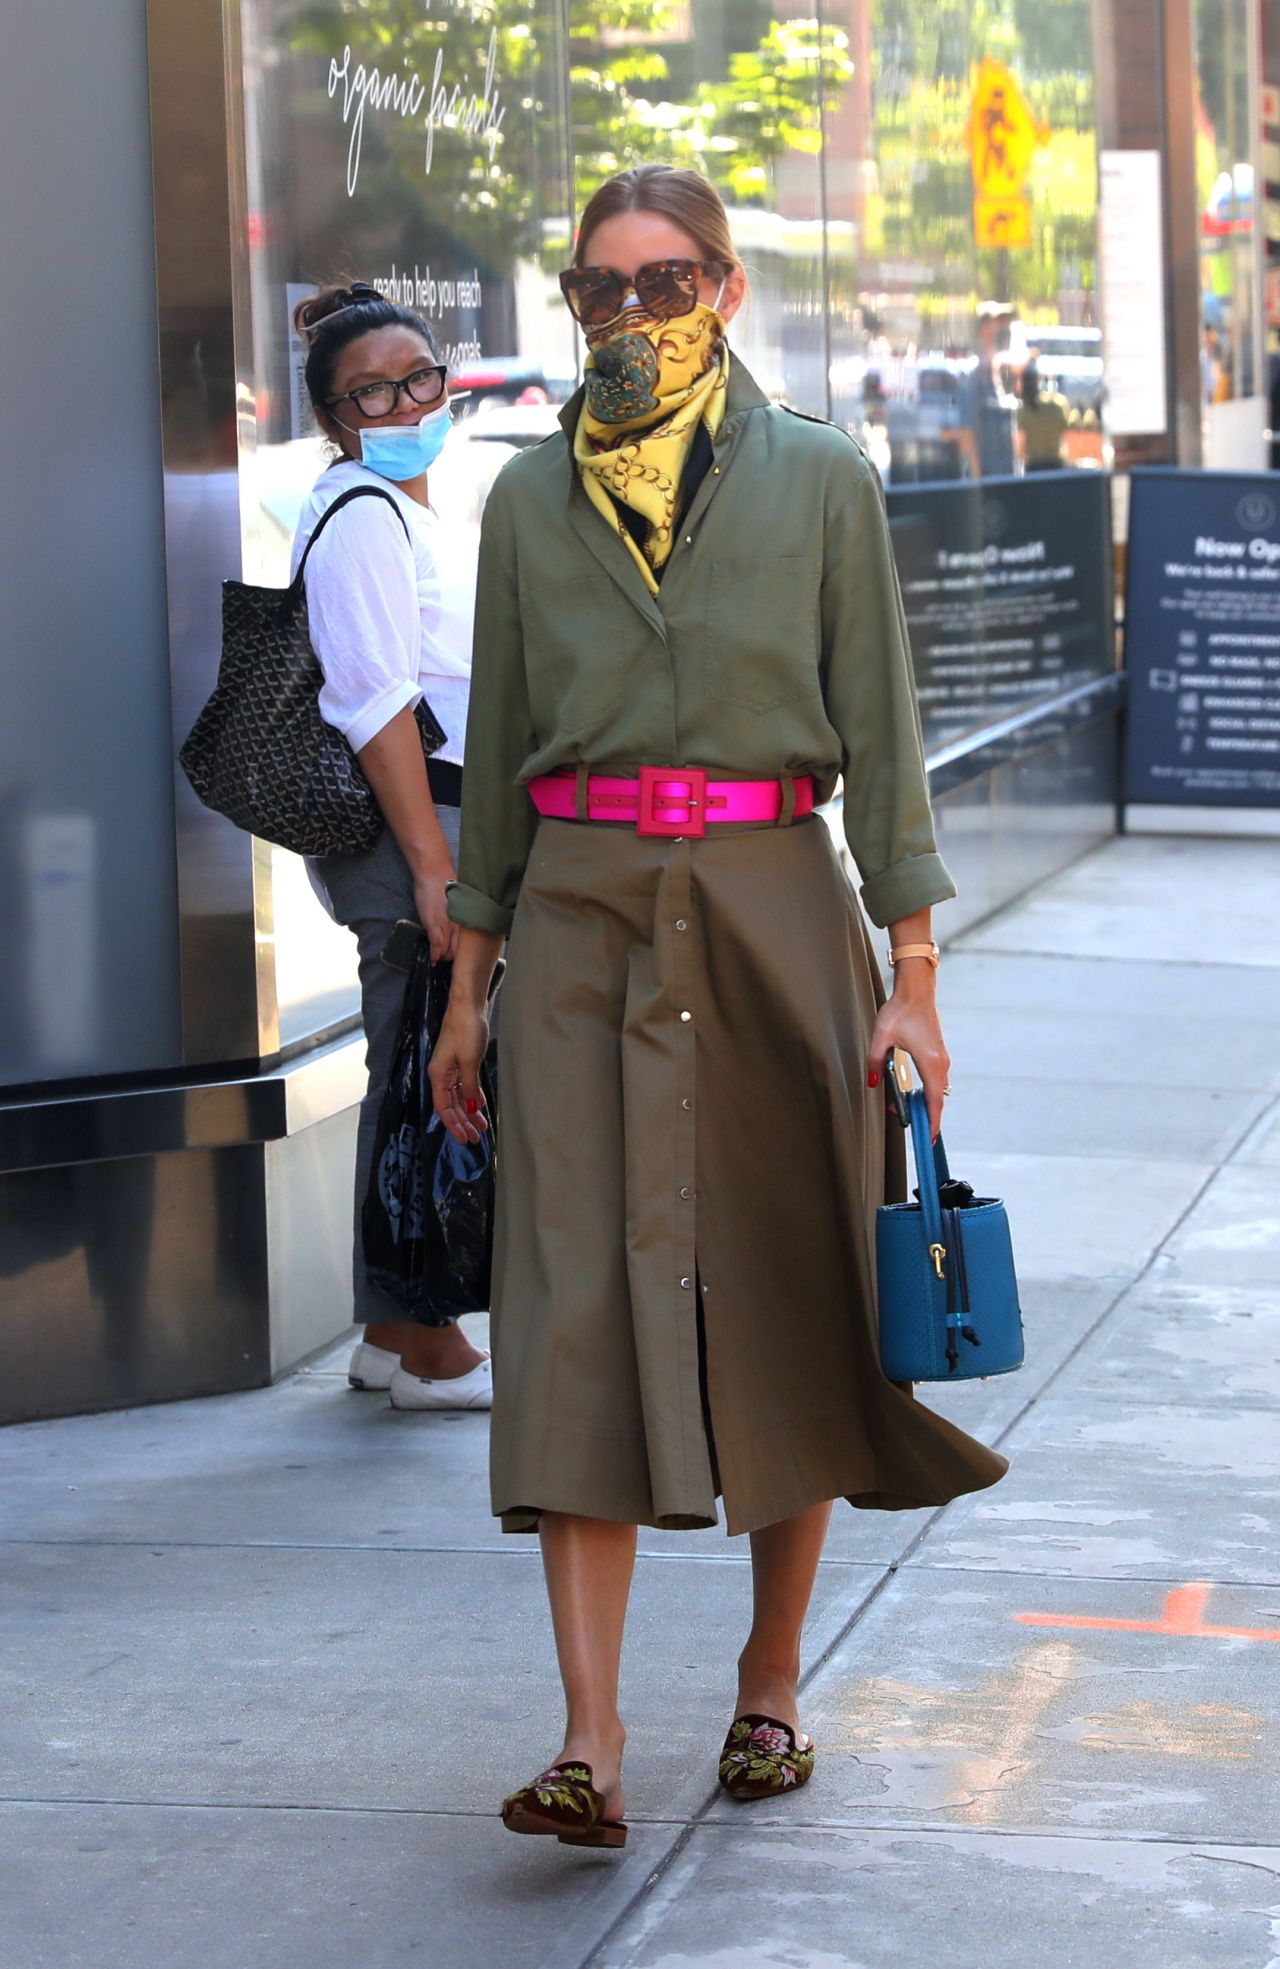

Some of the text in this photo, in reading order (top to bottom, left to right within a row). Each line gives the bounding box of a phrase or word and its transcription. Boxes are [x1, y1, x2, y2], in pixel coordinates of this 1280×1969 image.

[328, 45, 425, 197] organic
[373, 264, 482, 320] ready to help you reach
[1195, 536, 1246, 558] Now
